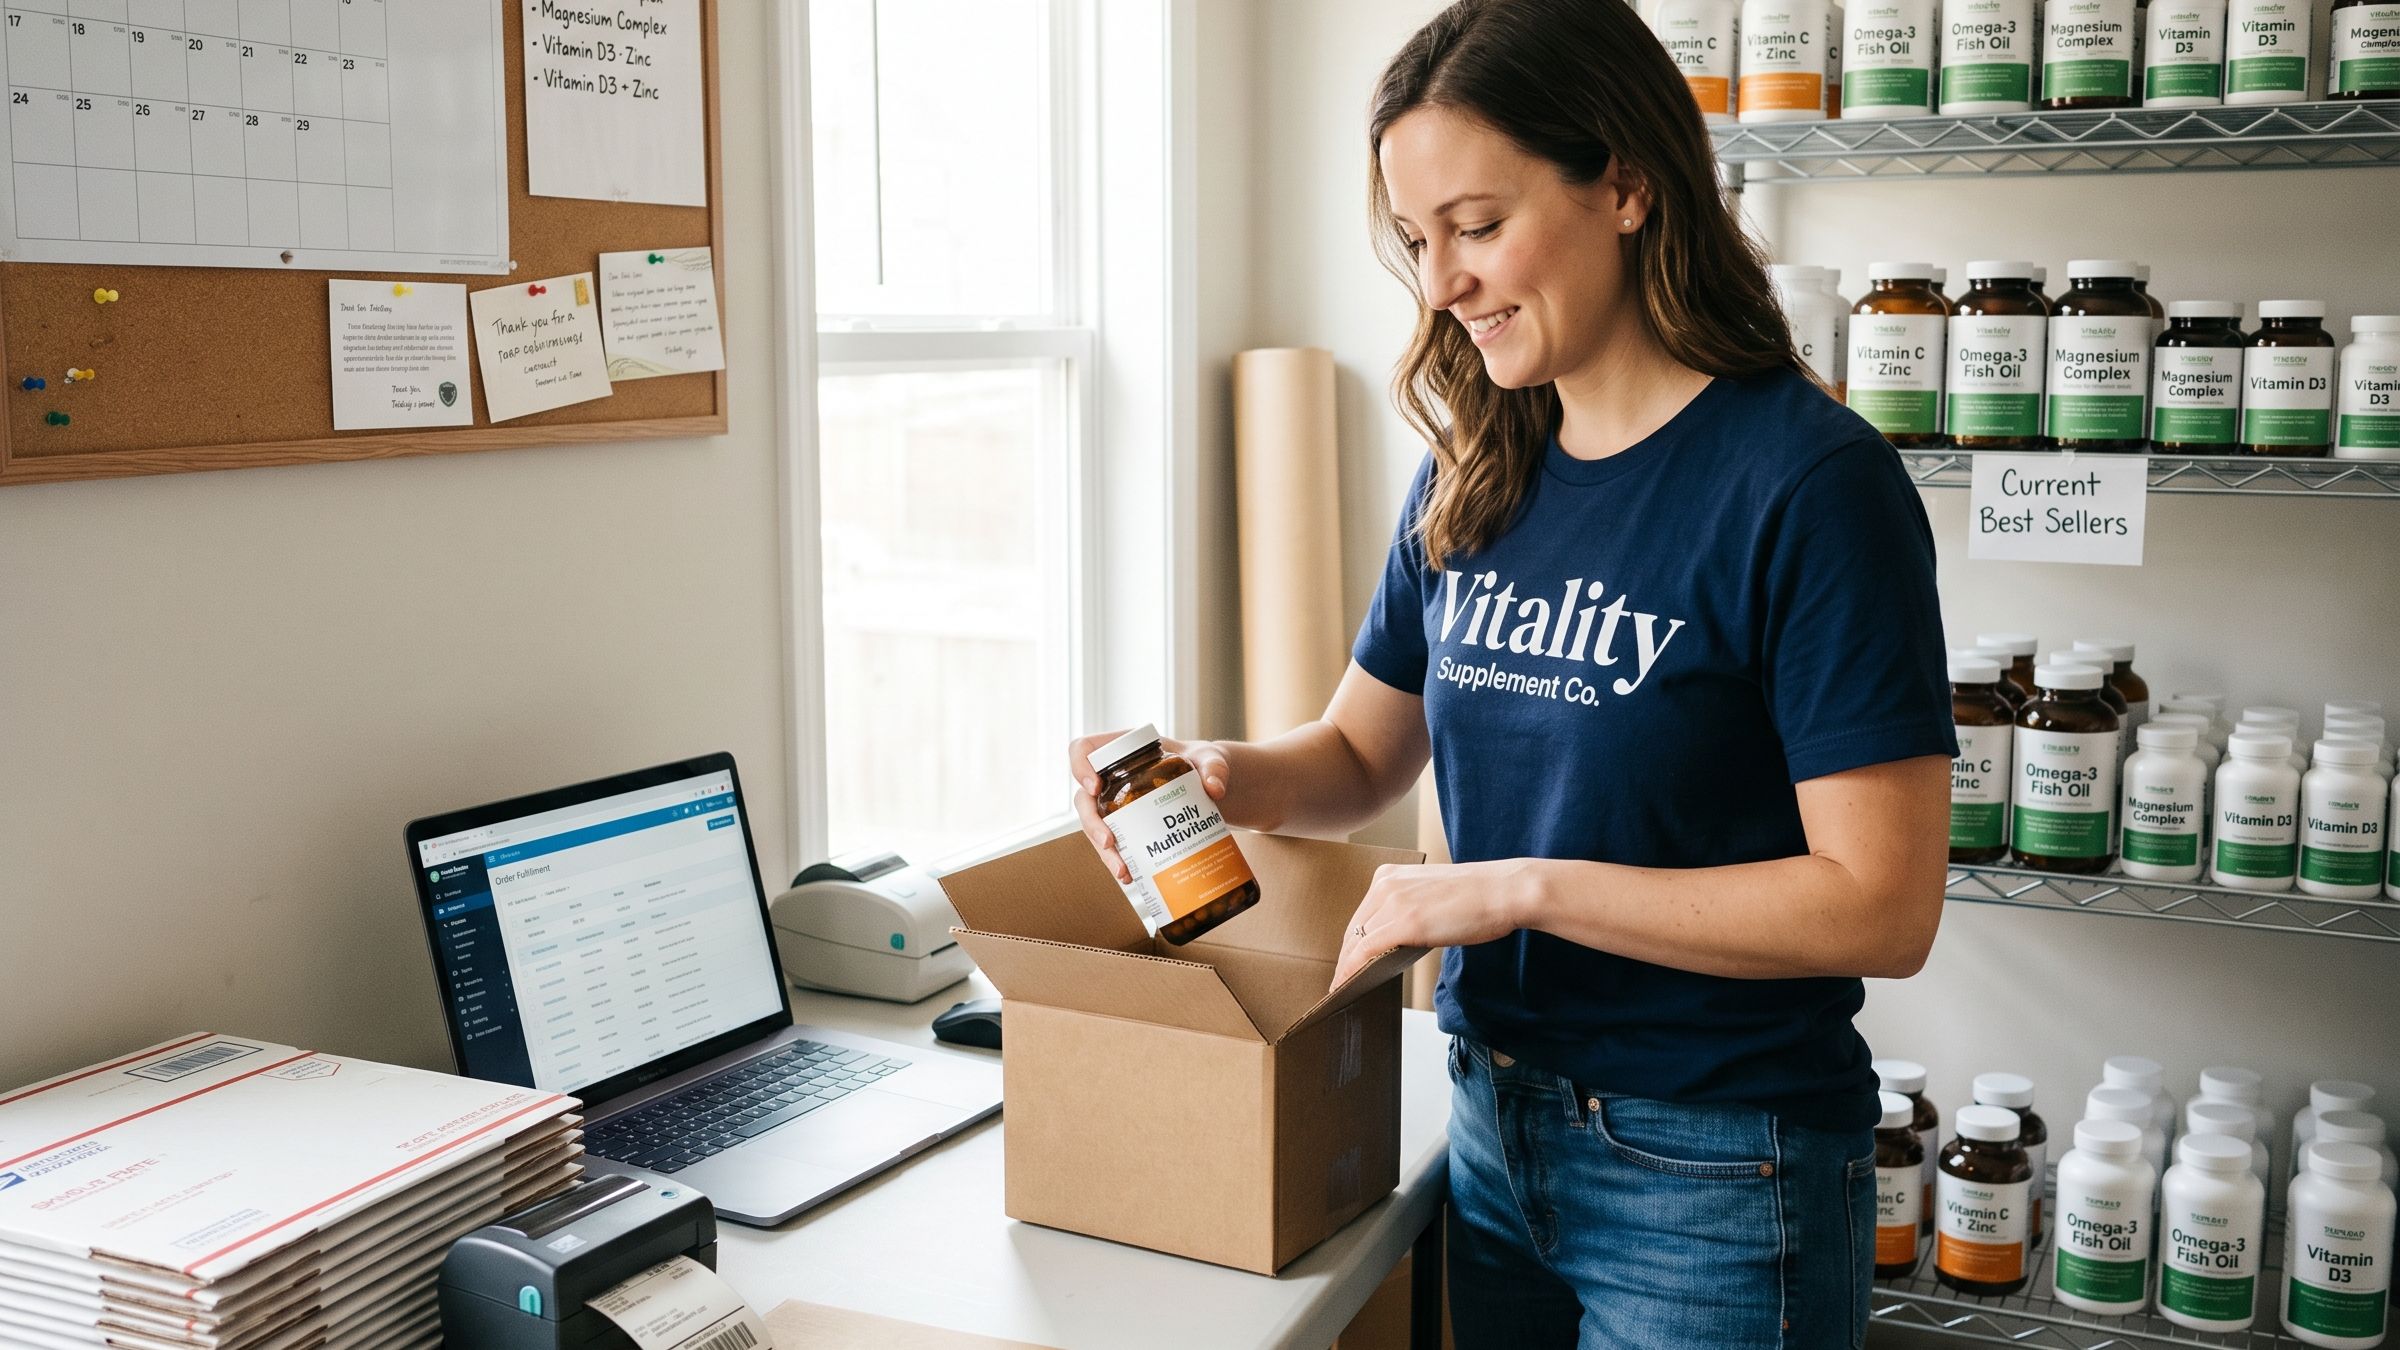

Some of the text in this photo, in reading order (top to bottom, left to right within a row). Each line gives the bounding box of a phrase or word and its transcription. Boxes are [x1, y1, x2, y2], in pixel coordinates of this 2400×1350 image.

[8, 16, 21, 27] 17
[541, 0, 667, 39] Magnesium Complex
[2242, 20, 2295, 33] Vitamin
[72, 24, 85, 35] 18
[1854, 26, 1916, 41] Omega-3
[1952, 21, 2016, 37] Omega-3
[2051, 20, 2122, 37] Magnesium
[2159, 27, 2210, 40] Vitamin
[132, 32, 144, 43] 19
[188, 39, 203, 50] 20
[1707, 37, 1717, 49] C
[1747, 32, 1809, 45] Vitamin C
[1957, 37, 2010, 51] Fish Oil
[2057, 35, 2113, 50] Complex
[2258, 34, 2277, 46] D3
[242, 46, 254, 58] 21
[542, 34, 592, 59] Vitamin
[597, 42, 616, 62] D3
[626, 47, 651, 67] Zinc
[1767, 48, 1796, 60] Zinc
[1858, 42, 1909, 56] Fish Oil
[2175, 41, 2193, 54] D3
[294, 53, 307, 65] 22
[343, 59, 354, 70] 23
[1676, 52, 1703, 64] Zinc
[544, 68, 594, 92] Vitamin
[599, 75, 617, 95] D3
[633, 79, 659, 100] Zinc
[13, 92, 28, 104] 24
[76, 98, 92, 110] 25
[136, 104, 150, 116] 26
[192, 110, 204, 121] 27
[246, 115, 259, 126] 28
[296, 120, 310, 131] 29
[492, 309, 575, 337] Thank you for a
[1802, 344, 1813, 356] C
[1857, 346, 1925, 359] Vitamin C
[1960, 348, 2027, 365] Omega-3
[2056, 349, 2140, 367] Magnesium
[1878, 364, 1911, 376] Zinc
[1964, 365, 2021, 378] Fish Oil
[2064, 367, 2131, 383] Complex
[2162, 370, 2233, 385] Magnesium
[2251, 377, 2327, 390] Vitamin D3
[2169, 385, 2224, 399] Complex
[2370, 394, 2390, 405] D3
[2001, 468, 2101, 496] Current
[1980, 506, 2128, 535] Best Sellers
[1440, 570, 1686, 695] Vitality
[1437, 656, 1600, 707] Supplement Co.
[1980, 759, 1991, 773] C
[2026, 763, 2097, 783] Omega-3
[2031, 780, 2090, 797] Fish Oil
[2128, 797, 2194, 813] Magnesium
[1163, 804, 1200, 829] Daily
[2133, 811, 2185, 825] Complex
[2224, 811, 2292, 827] Vitamin D3
[2308, 817, 2378, 834] Vitamin D3
[1146, 811, 1222, 858] Multivitamin
[495, 874, 516, 886] Order
[1895, 1192, 1905, 1204] C
[1946, 1200, 2009, 1220] Vitamin C
[1968, 1219, 1997, 1233] Zinc
[2067, 1213, 2137, 1237] Omega-3
[2072, 1231, 2131, 1251] Fish Oil
[2172, 1228, 2245, 1253] Omega-3
[2177, 1246, 2239, 1268] Fish Oil
[2308, 1245, 2373, 1266] Vitamin
[2329, 1268, 2351, 1283] D3
